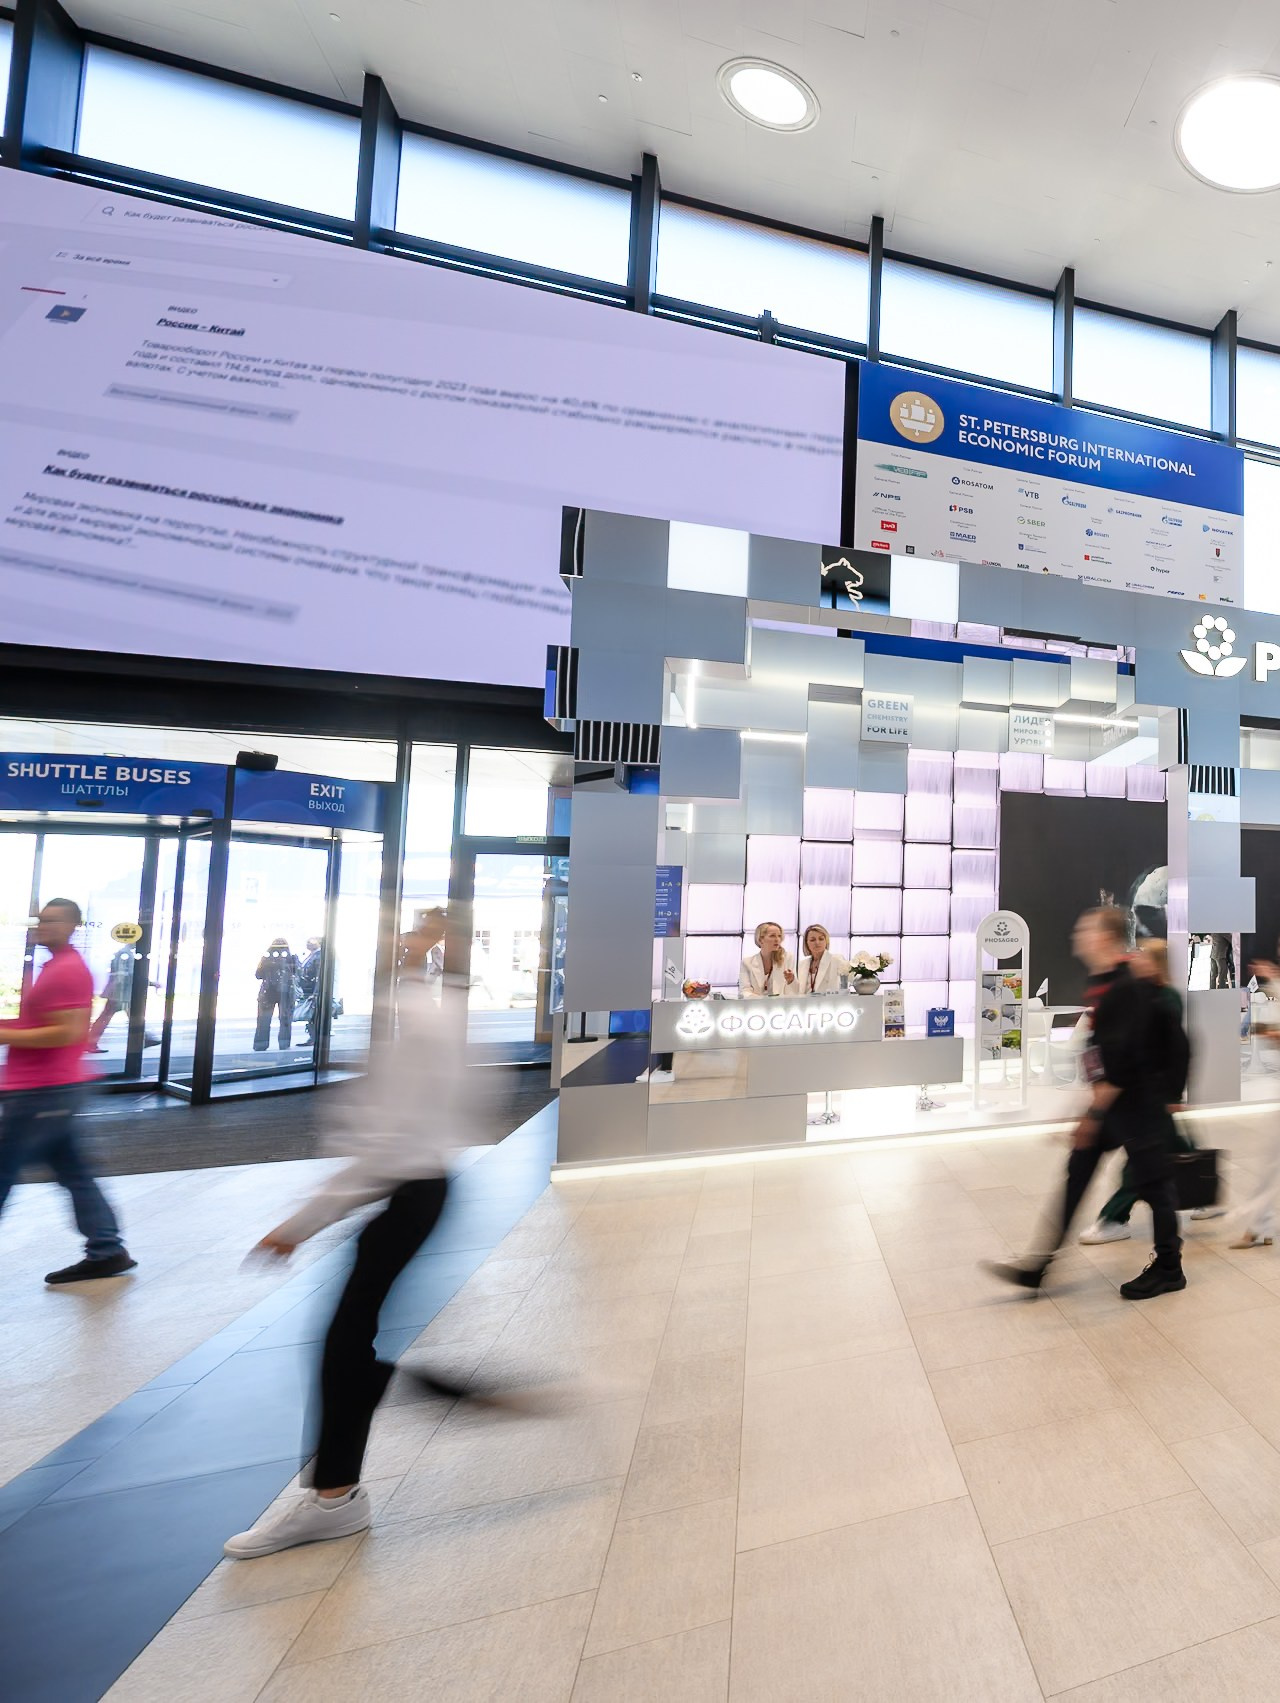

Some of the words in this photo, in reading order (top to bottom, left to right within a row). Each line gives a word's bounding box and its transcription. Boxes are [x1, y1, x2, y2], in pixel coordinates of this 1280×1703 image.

[156, 318, 199, 331] Россия
[209, 324, 246, 337] Китай
[958, 430, 1045, 460] ECONOMIC
[1048, 450, 1101, 472] FORUM
[959, 414, 981, 430] ST.
[983, 416, 1079, 451] PETERSBURG
[1082, 440, 1196, 477] INTERNATIONAL
[43, 464, 66, 477] Как
[67, 468, 105, 485] будет
[106, 476, 188, 498] развиваться
[961, 479, 994, 491] ROSATOM
[1024, 490, 1040, 500] VTB
[958, 506, 974, 515] PSB
[1026, 518, 1046, 527] SBER
[1211, 527, 1234, 536] NOVATEK
[867, 699, 909, 712] GREEN
[866, 713, 909, 723] CHEMISTRY
[867, 726, 888, 734] FOR
[889, 727, 909, 736] LIFE
[7, 762, 108, 781] SHUTTLE
[115, 766, 192, 785] BUSES
[60, 783, 129, 798] ШАТТЛЫ
[310, 782, 346, 800] EXIT
[308, 799, 346, 814] ВЫХОД
[720, 1010, 856, 1034] ФОСАГРО
